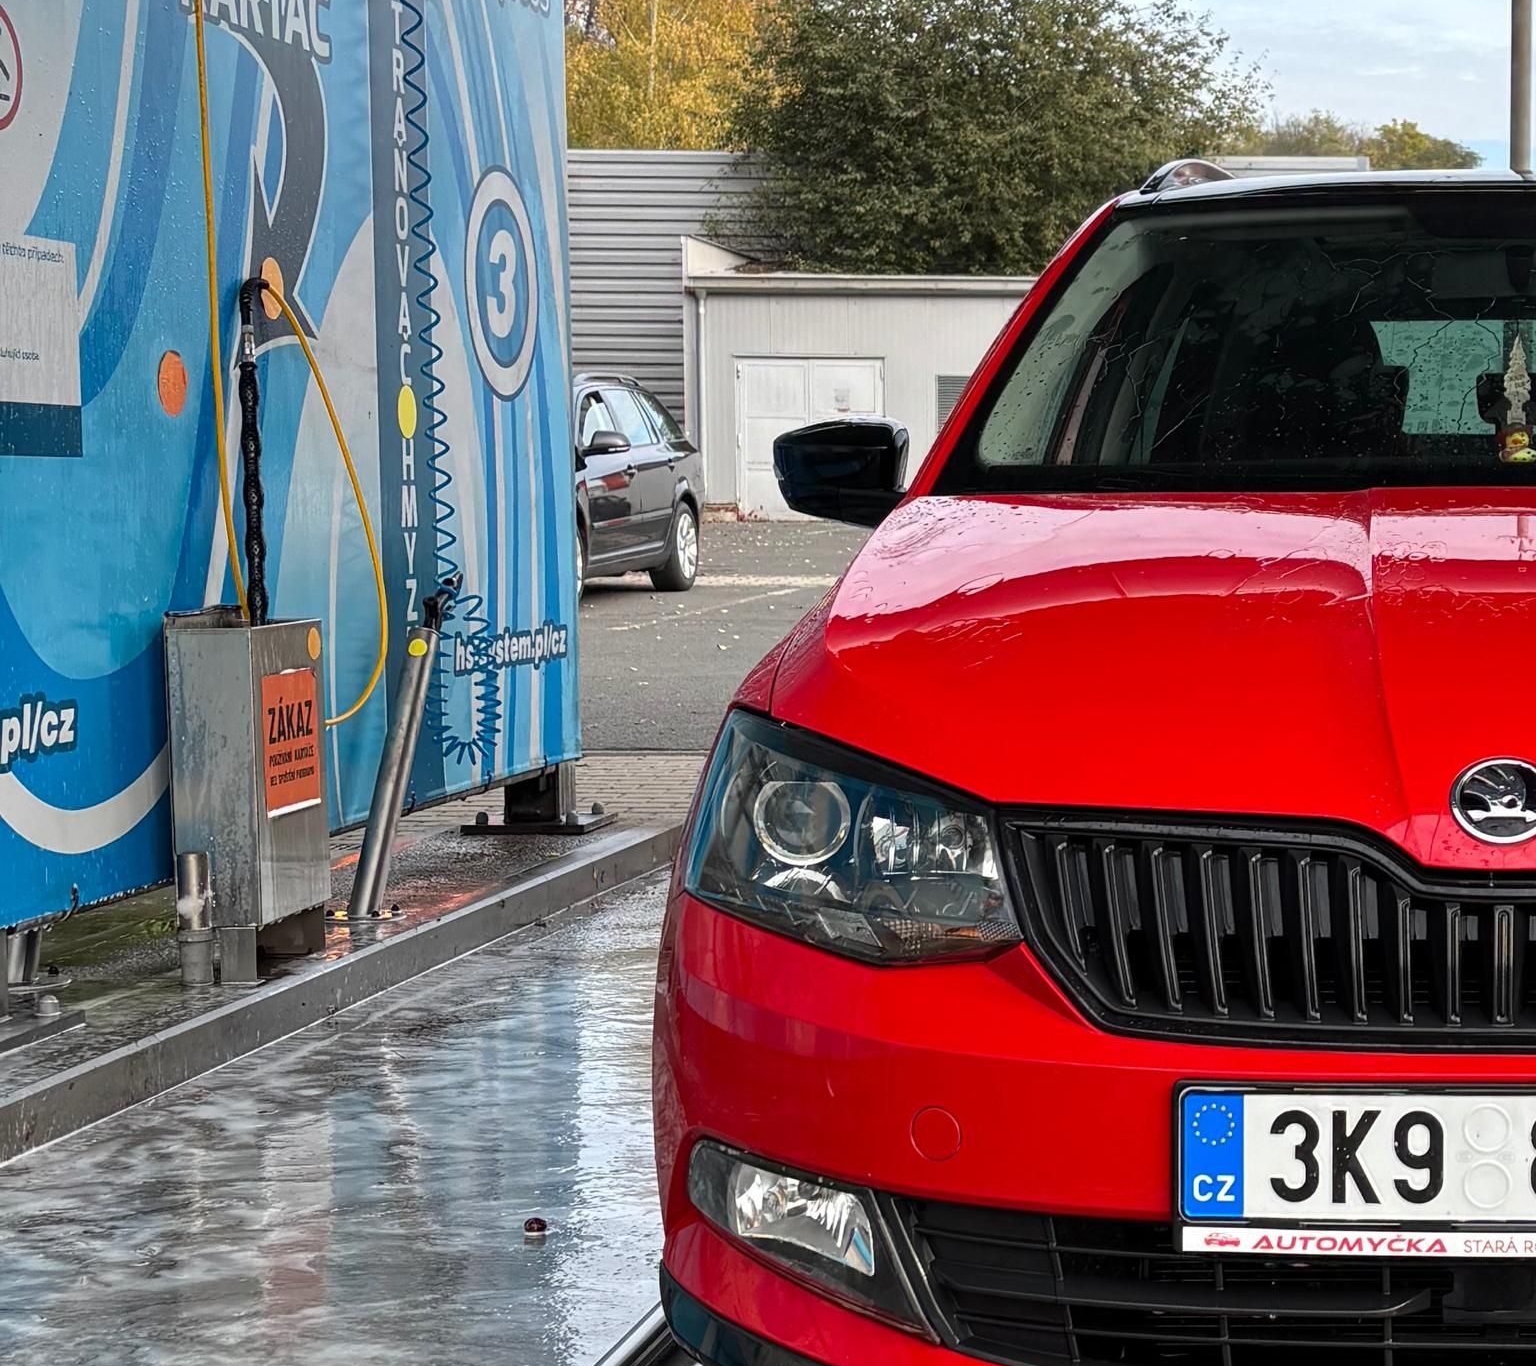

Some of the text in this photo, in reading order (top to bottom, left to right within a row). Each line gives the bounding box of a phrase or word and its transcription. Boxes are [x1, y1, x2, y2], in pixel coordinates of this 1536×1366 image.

[486, 229, 516, 339] 3
[268, 696, 313, 745] ZÁKAZ
[1270, 1110, 1443, 1204] 3K9
[1193, 1175, 1235, 1202] CZ
[1252, 1235, 1447, 1253] AUTOMYČKA
[1464, 1238, 1518, 1253] STARÁ
